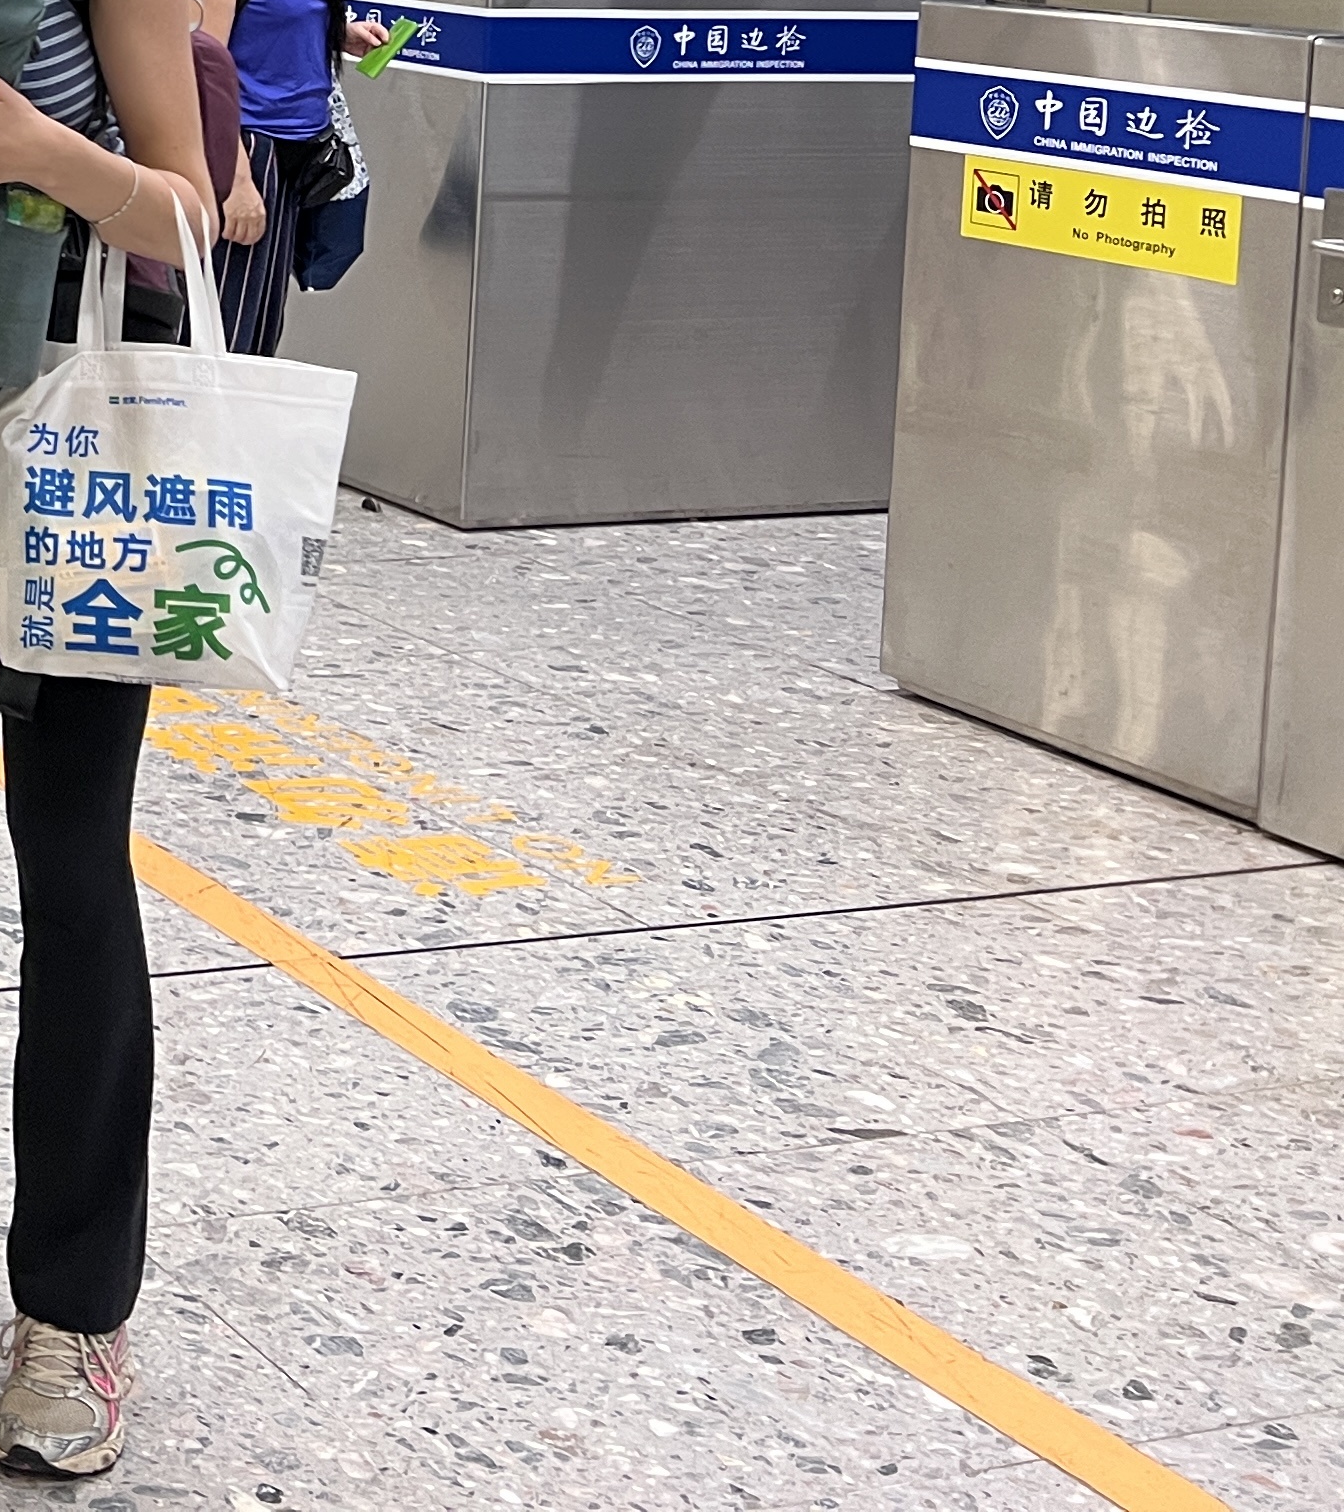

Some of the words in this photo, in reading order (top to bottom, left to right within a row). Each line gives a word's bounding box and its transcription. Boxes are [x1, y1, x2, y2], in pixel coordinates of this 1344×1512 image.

[673, 23, 807, 56] 中国边检
[672, 59, 698, 69] CHINA
[1034, 89, 1220, 150] 中国边检
[1033, 135, 1068, 151] CHINA
[1070, 140, 1144, 162] IMMIGRATION
[1147, 151, 1218, 172] INSPECTION
[1028, 179, 1227, 239] 请勿拍照
[1072, 227, 1089, 241] No
[1096, 231, 1176, 258] Photography
[26, 422, 100, 458] 为你
[23, 465, 254, 531] 避风遮雨
[23, 525, 153, 573] 的地方
[19, 575, 55, 651] 就是
[61, 578, 234, 661] 全家
